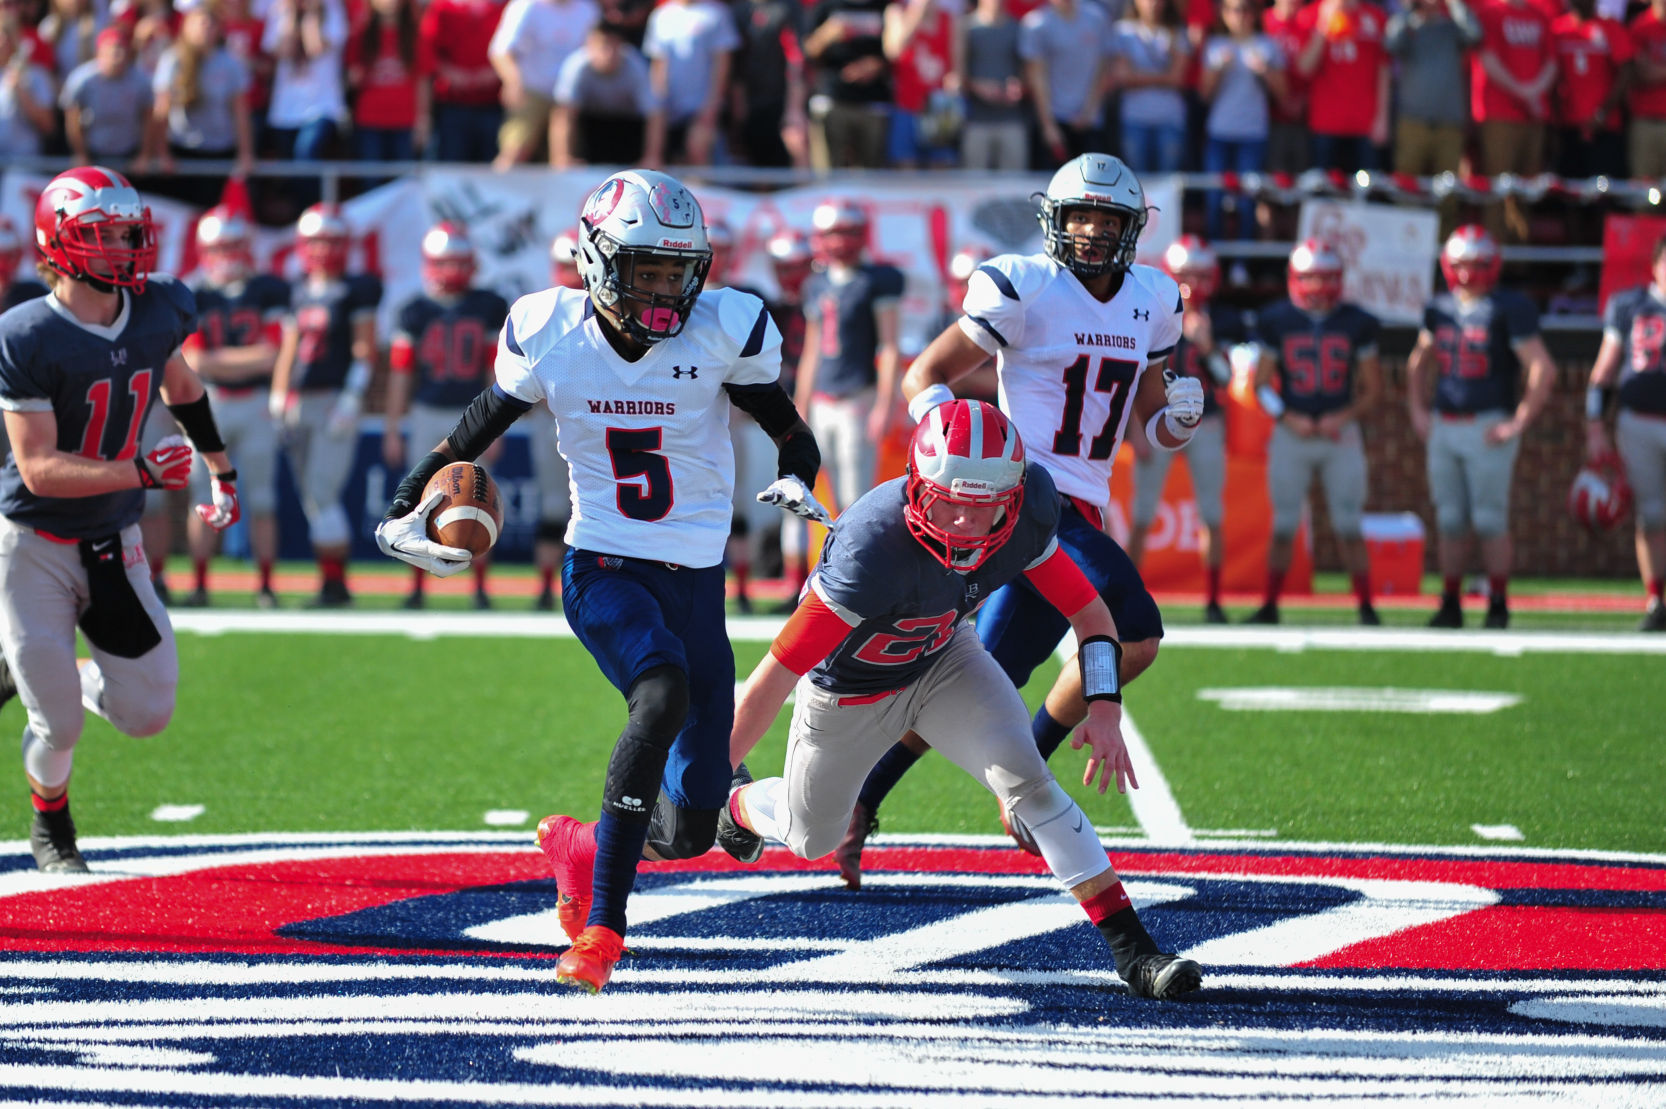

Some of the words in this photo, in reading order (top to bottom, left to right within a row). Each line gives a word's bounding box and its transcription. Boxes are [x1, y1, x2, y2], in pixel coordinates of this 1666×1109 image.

[662, 239, 693, 249] Riddell
[1074, 333, 1136, 350] WARRIORS
[1283, 333, 1350, 394] 56
[72, 368, 153, 461] 11
[587, 399, 676, 416] WARRIORS
[1052, 353, 1139, 461] 17
[452, 465, 465, 496] Wilson
[606, 425, 675, 523] 5
[961, 480, 988, 490] Riddell
